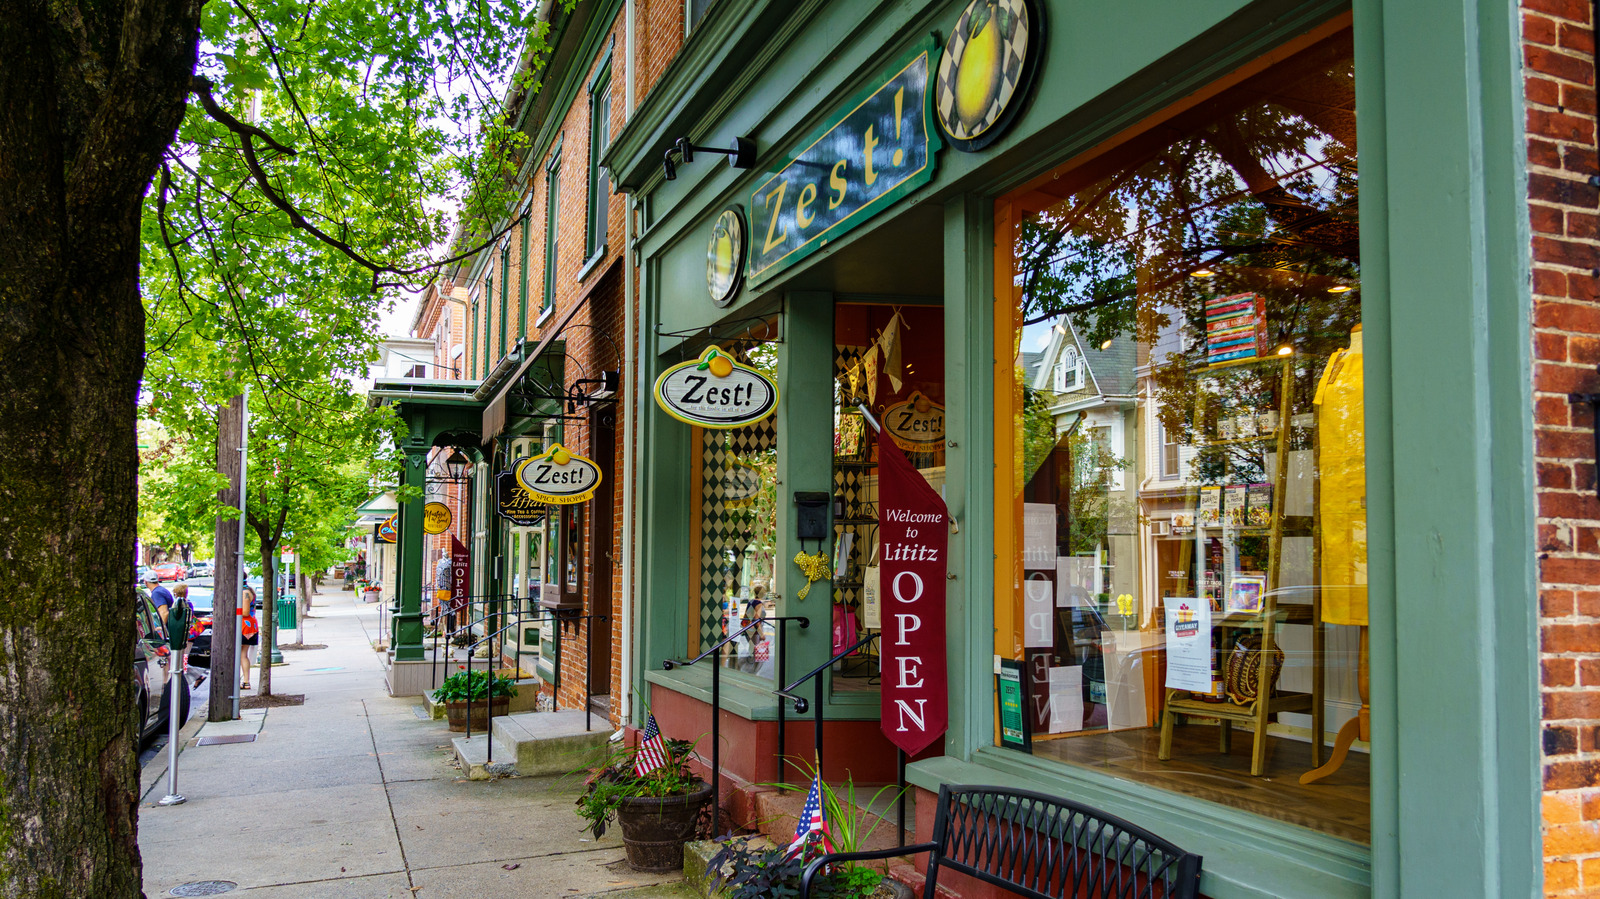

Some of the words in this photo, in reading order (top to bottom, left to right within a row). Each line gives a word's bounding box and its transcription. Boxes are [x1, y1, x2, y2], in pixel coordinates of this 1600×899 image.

[762, 85, 904, 255] Zest!
[680, 374, 753, 407] Zest!
[896, 411, 943, 433] Zest!
[534, 464, 584, 485] Zest!
[535, 493, 557, 503] SPICE
[559, 493, 589, 504] SHOPPE
[885, 508, 943, 524] Welcome
[905, 526, 919, 538] to
[884, 543, 939, 562] Lititz
[455, 568, 465, 607] OPEN
[892, 571, 928, 732] OPEN
